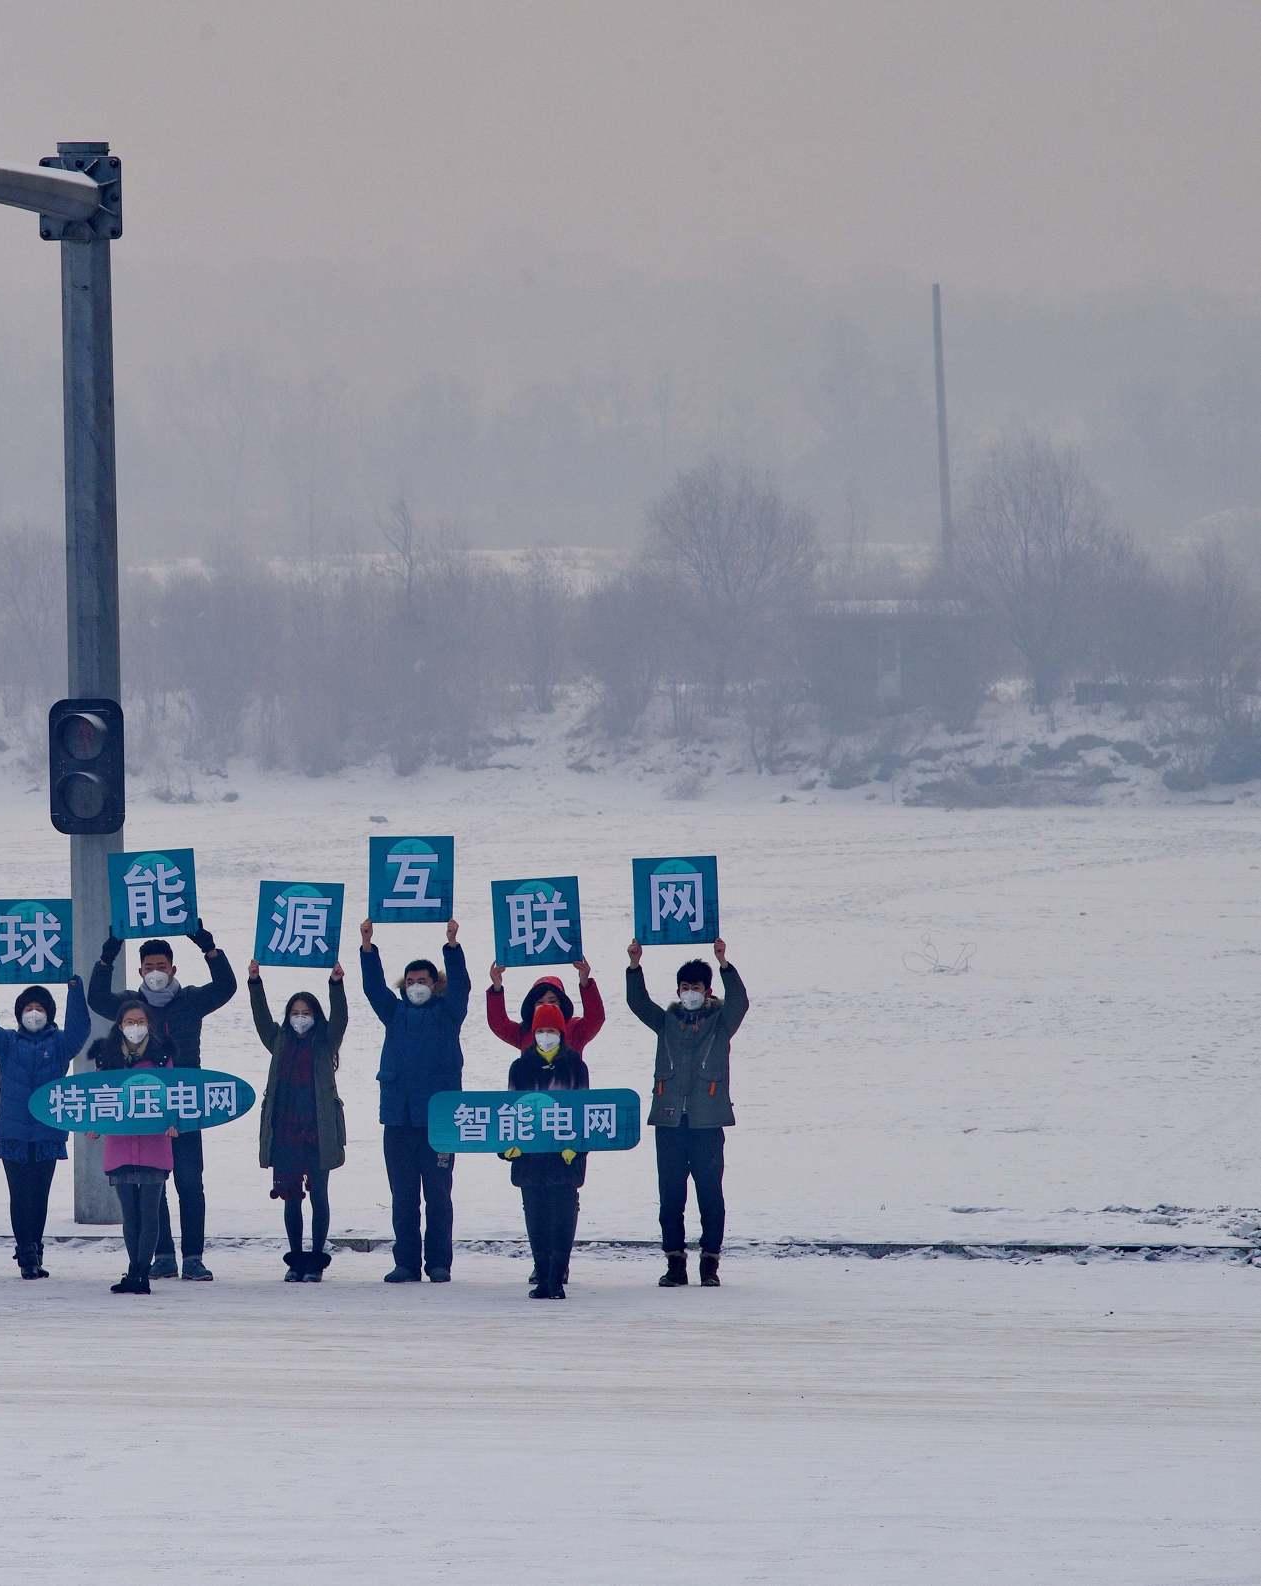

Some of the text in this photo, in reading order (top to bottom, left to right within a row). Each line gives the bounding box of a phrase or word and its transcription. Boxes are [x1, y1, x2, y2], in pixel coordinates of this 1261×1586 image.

[123, 863, 188, 927] 能
[383, 853, 441, 908] 互
[650, 872, 704, 933] 网
[0, 911, 64, 973] 球
[268, 894, 332, 956] 源
[506, 890, 572, 955] 联
[49, 1080, 238, 1123] 特高压电网
[453, 1103, 617, 1142] 智能电网
